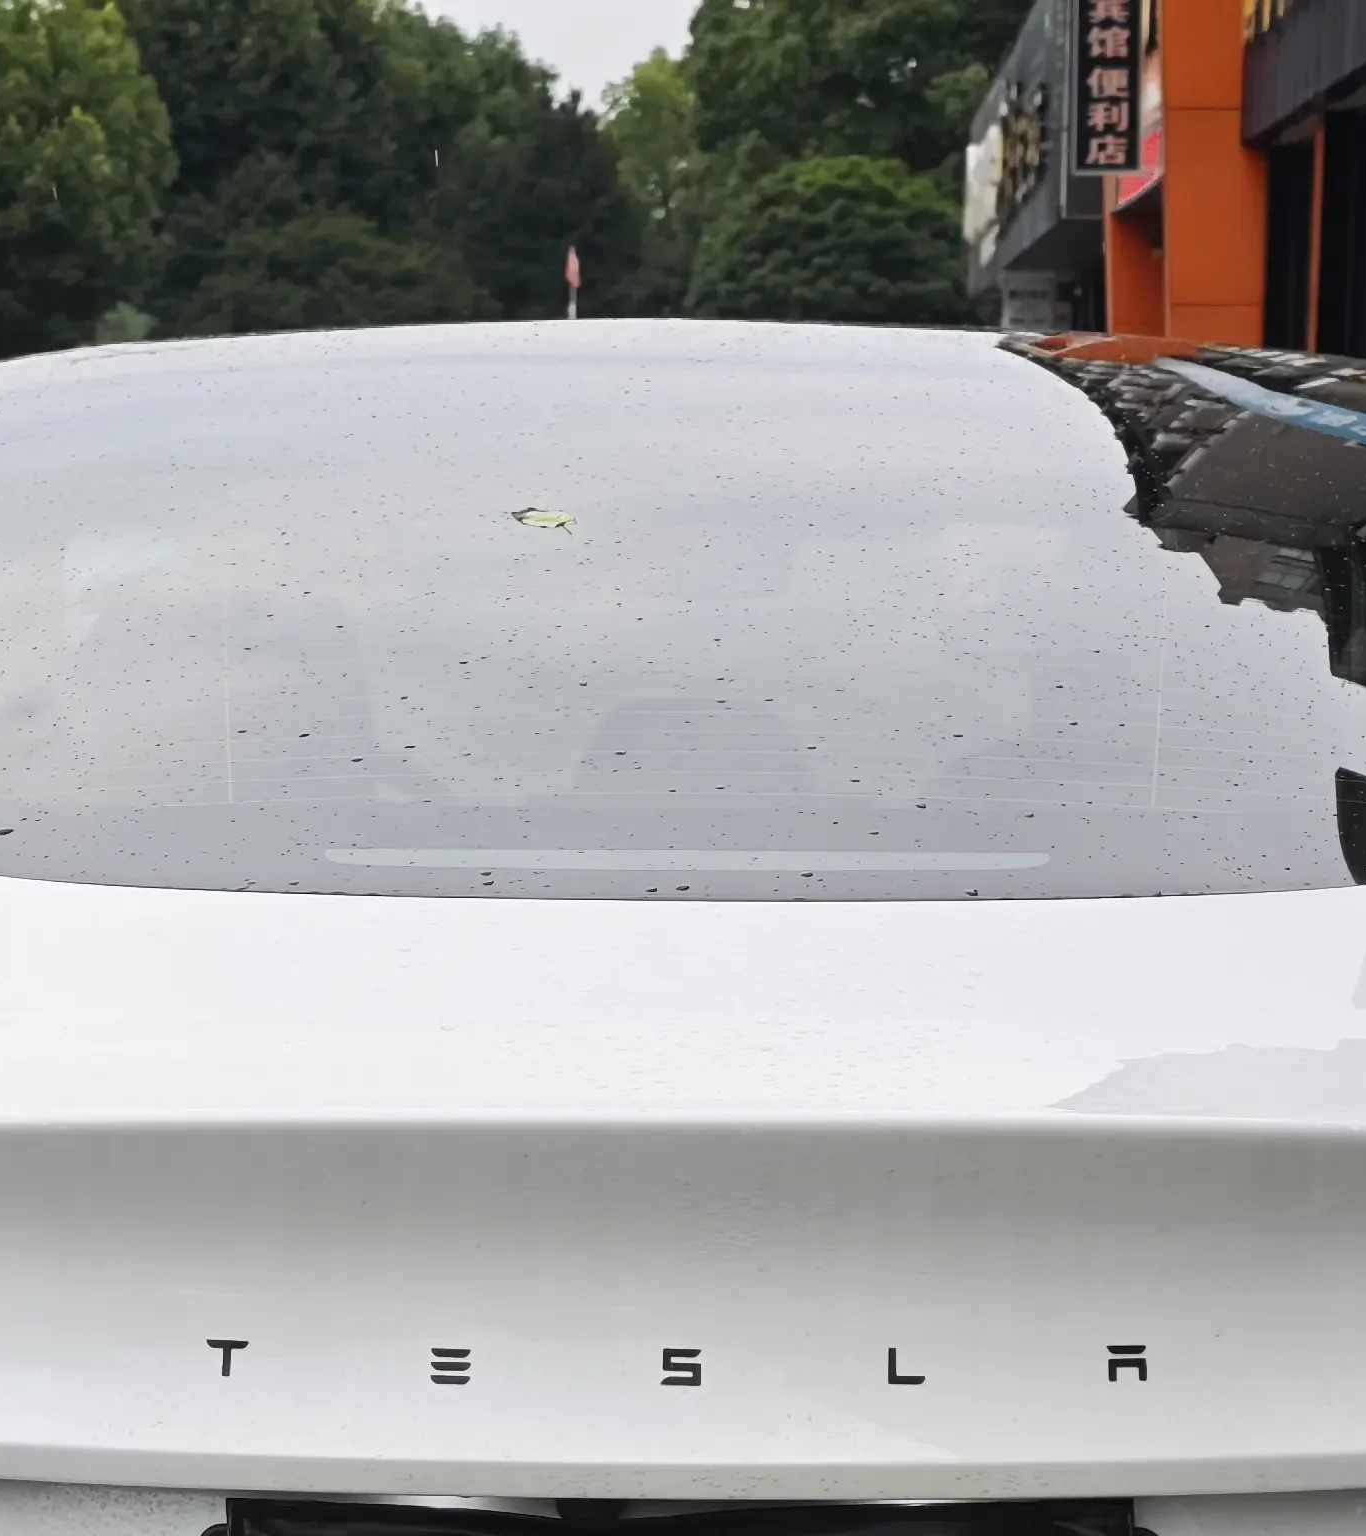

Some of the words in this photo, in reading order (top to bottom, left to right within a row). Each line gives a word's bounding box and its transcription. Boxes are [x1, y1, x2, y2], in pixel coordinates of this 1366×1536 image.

[1085, 67, 1130, 165] 便利店
[206, 1338, 1148, 1387] TESLA
